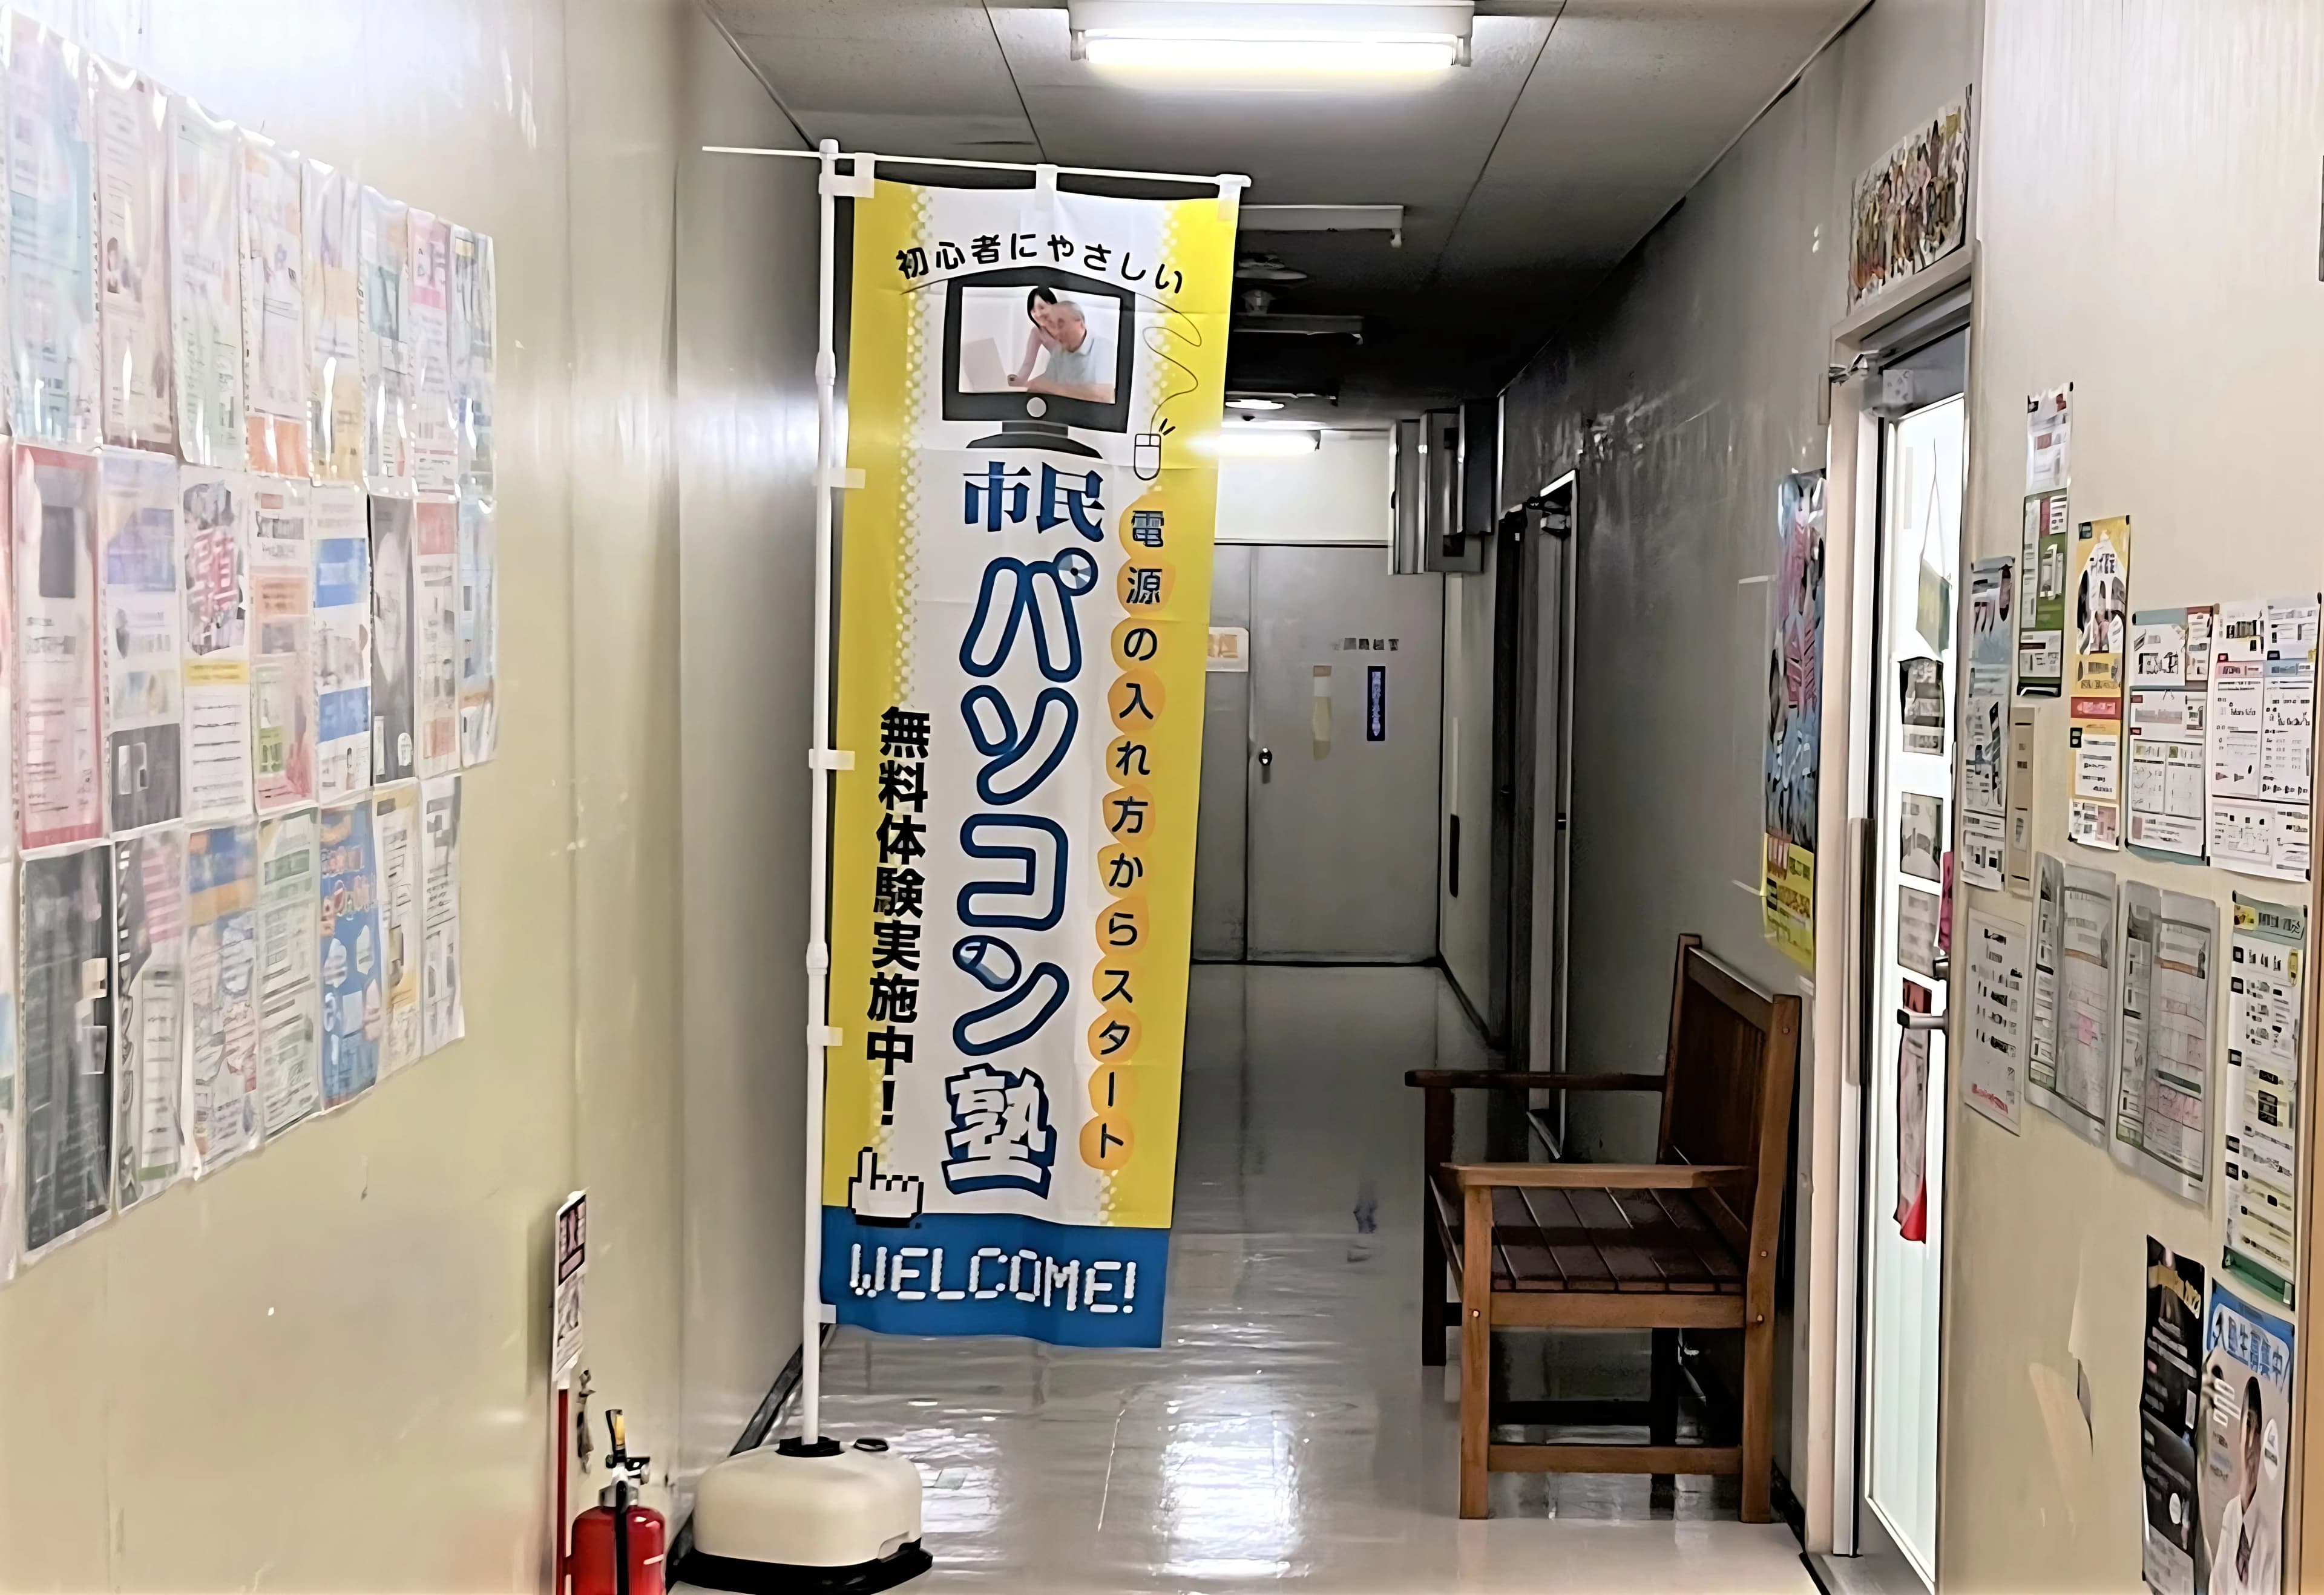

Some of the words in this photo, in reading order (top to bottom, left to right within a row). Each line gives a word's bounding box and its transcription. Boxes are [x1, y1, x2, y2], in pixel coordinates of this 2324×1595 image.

[896, 232, 1183, 295] 初心者にやさしい
[963, 460, 1106, 543] 市民
[1100, 509, 1165, 1159] 電源の入れ方からスタート
[865, 706, 931, 1126] 無料体験実施中!
[849, 1243, 1138, 1314] WELCOME!
